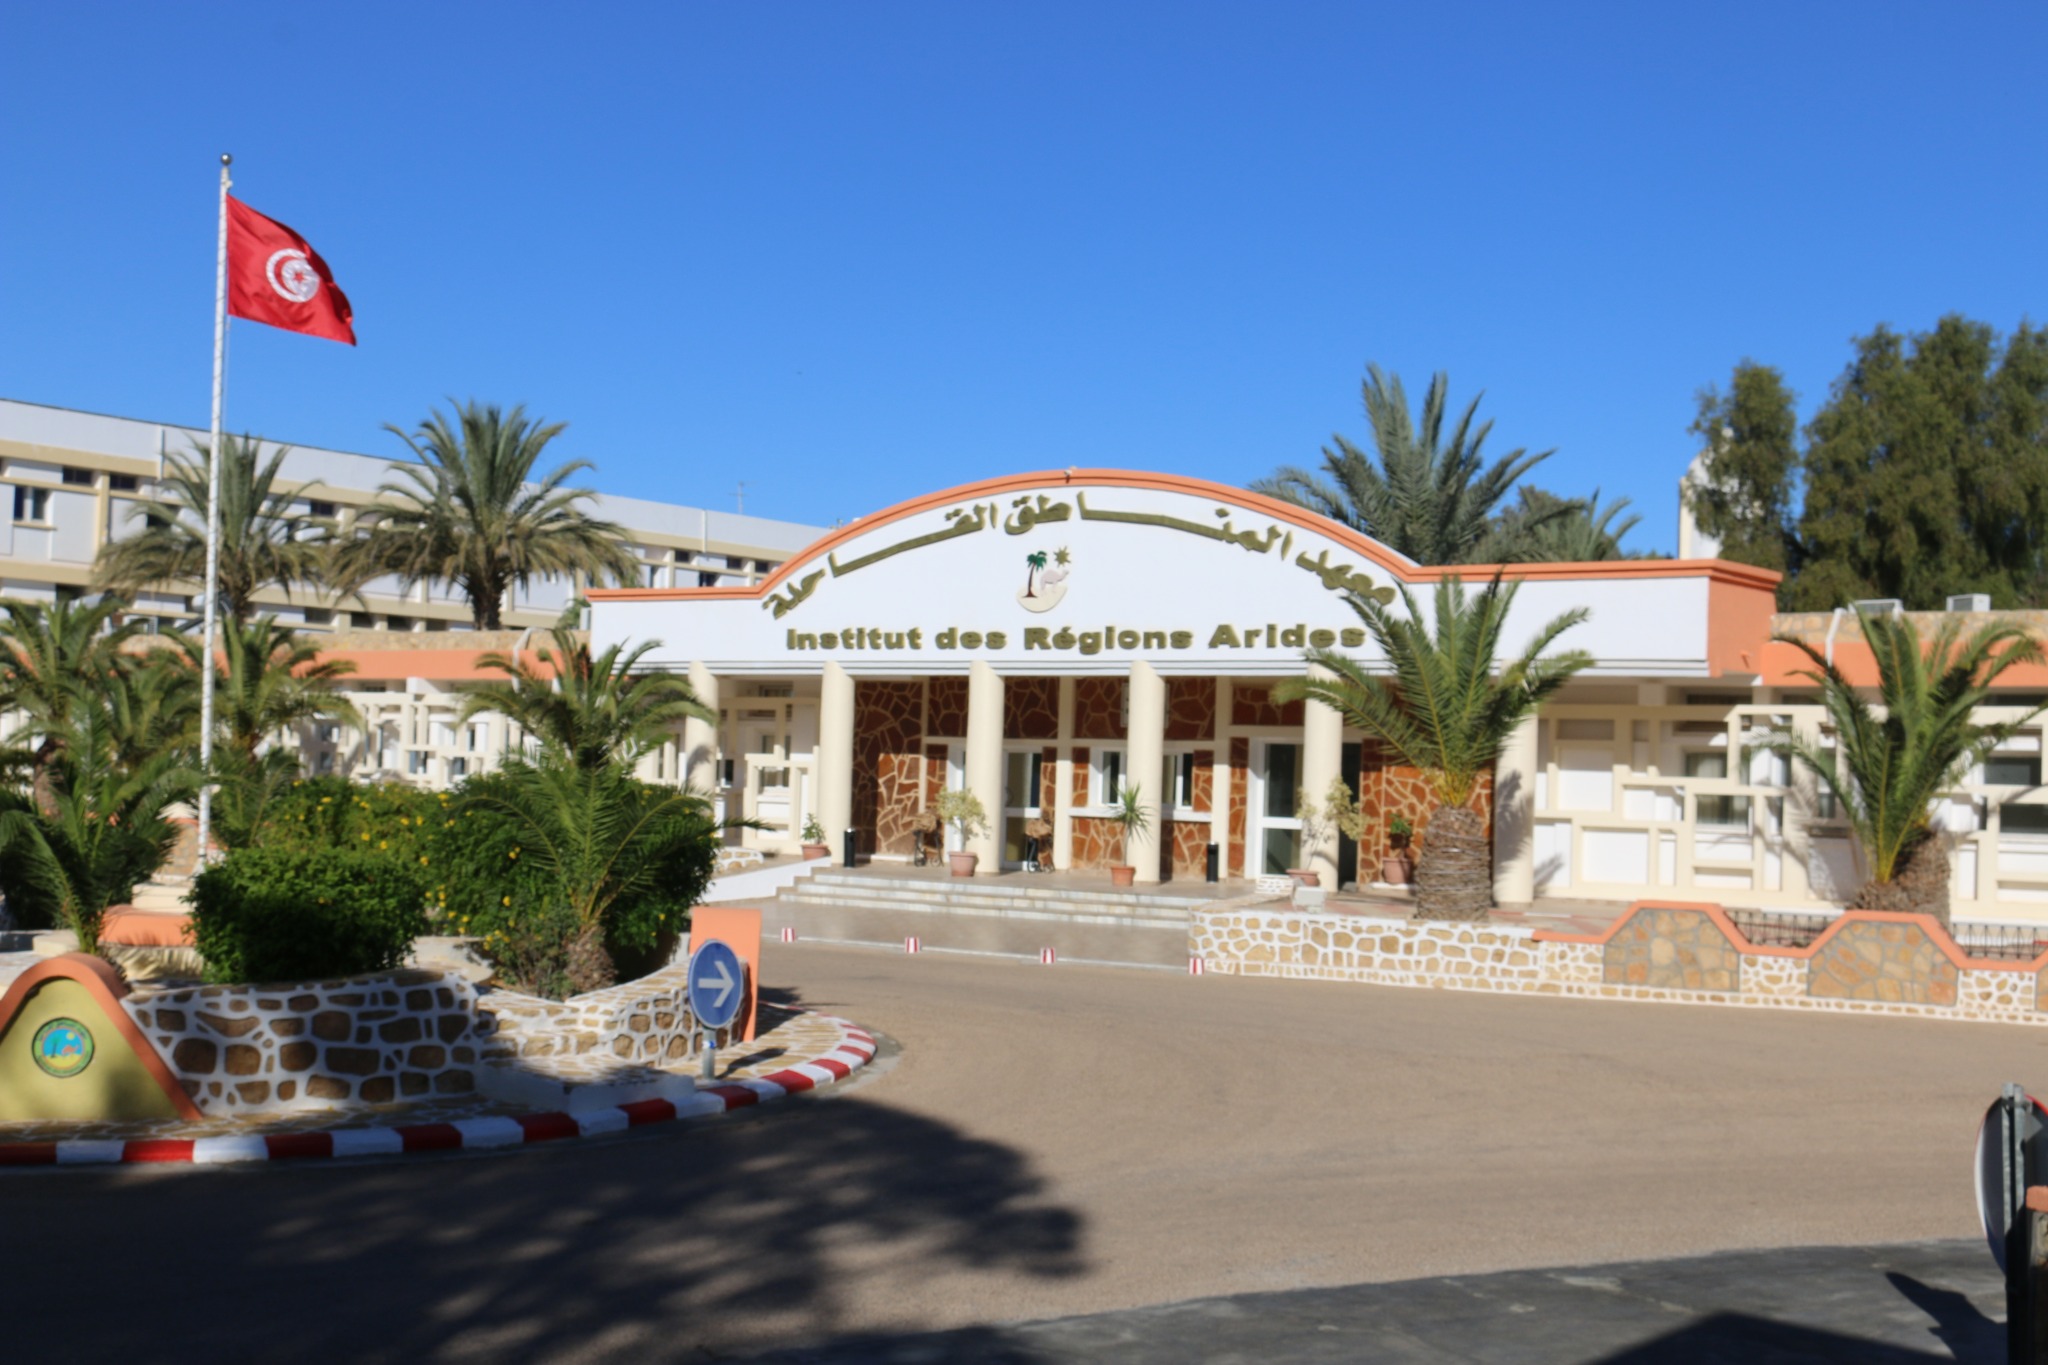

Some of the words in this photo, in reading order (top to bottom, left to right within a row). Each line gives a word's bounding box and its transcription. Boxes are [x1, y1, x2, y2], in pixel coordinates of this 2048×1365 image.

[1004, 490, 1293, 560] المناطق
[762, 501, 998, 620] القاحلة
[1295, 549, 1396, 606] معهد
[785, 627, 922, 651] Institut
[935, 626, 1007, 651] des
[1023, 625, 1194, 656] Régions
[1207, 623, 1366, 650] Arides
